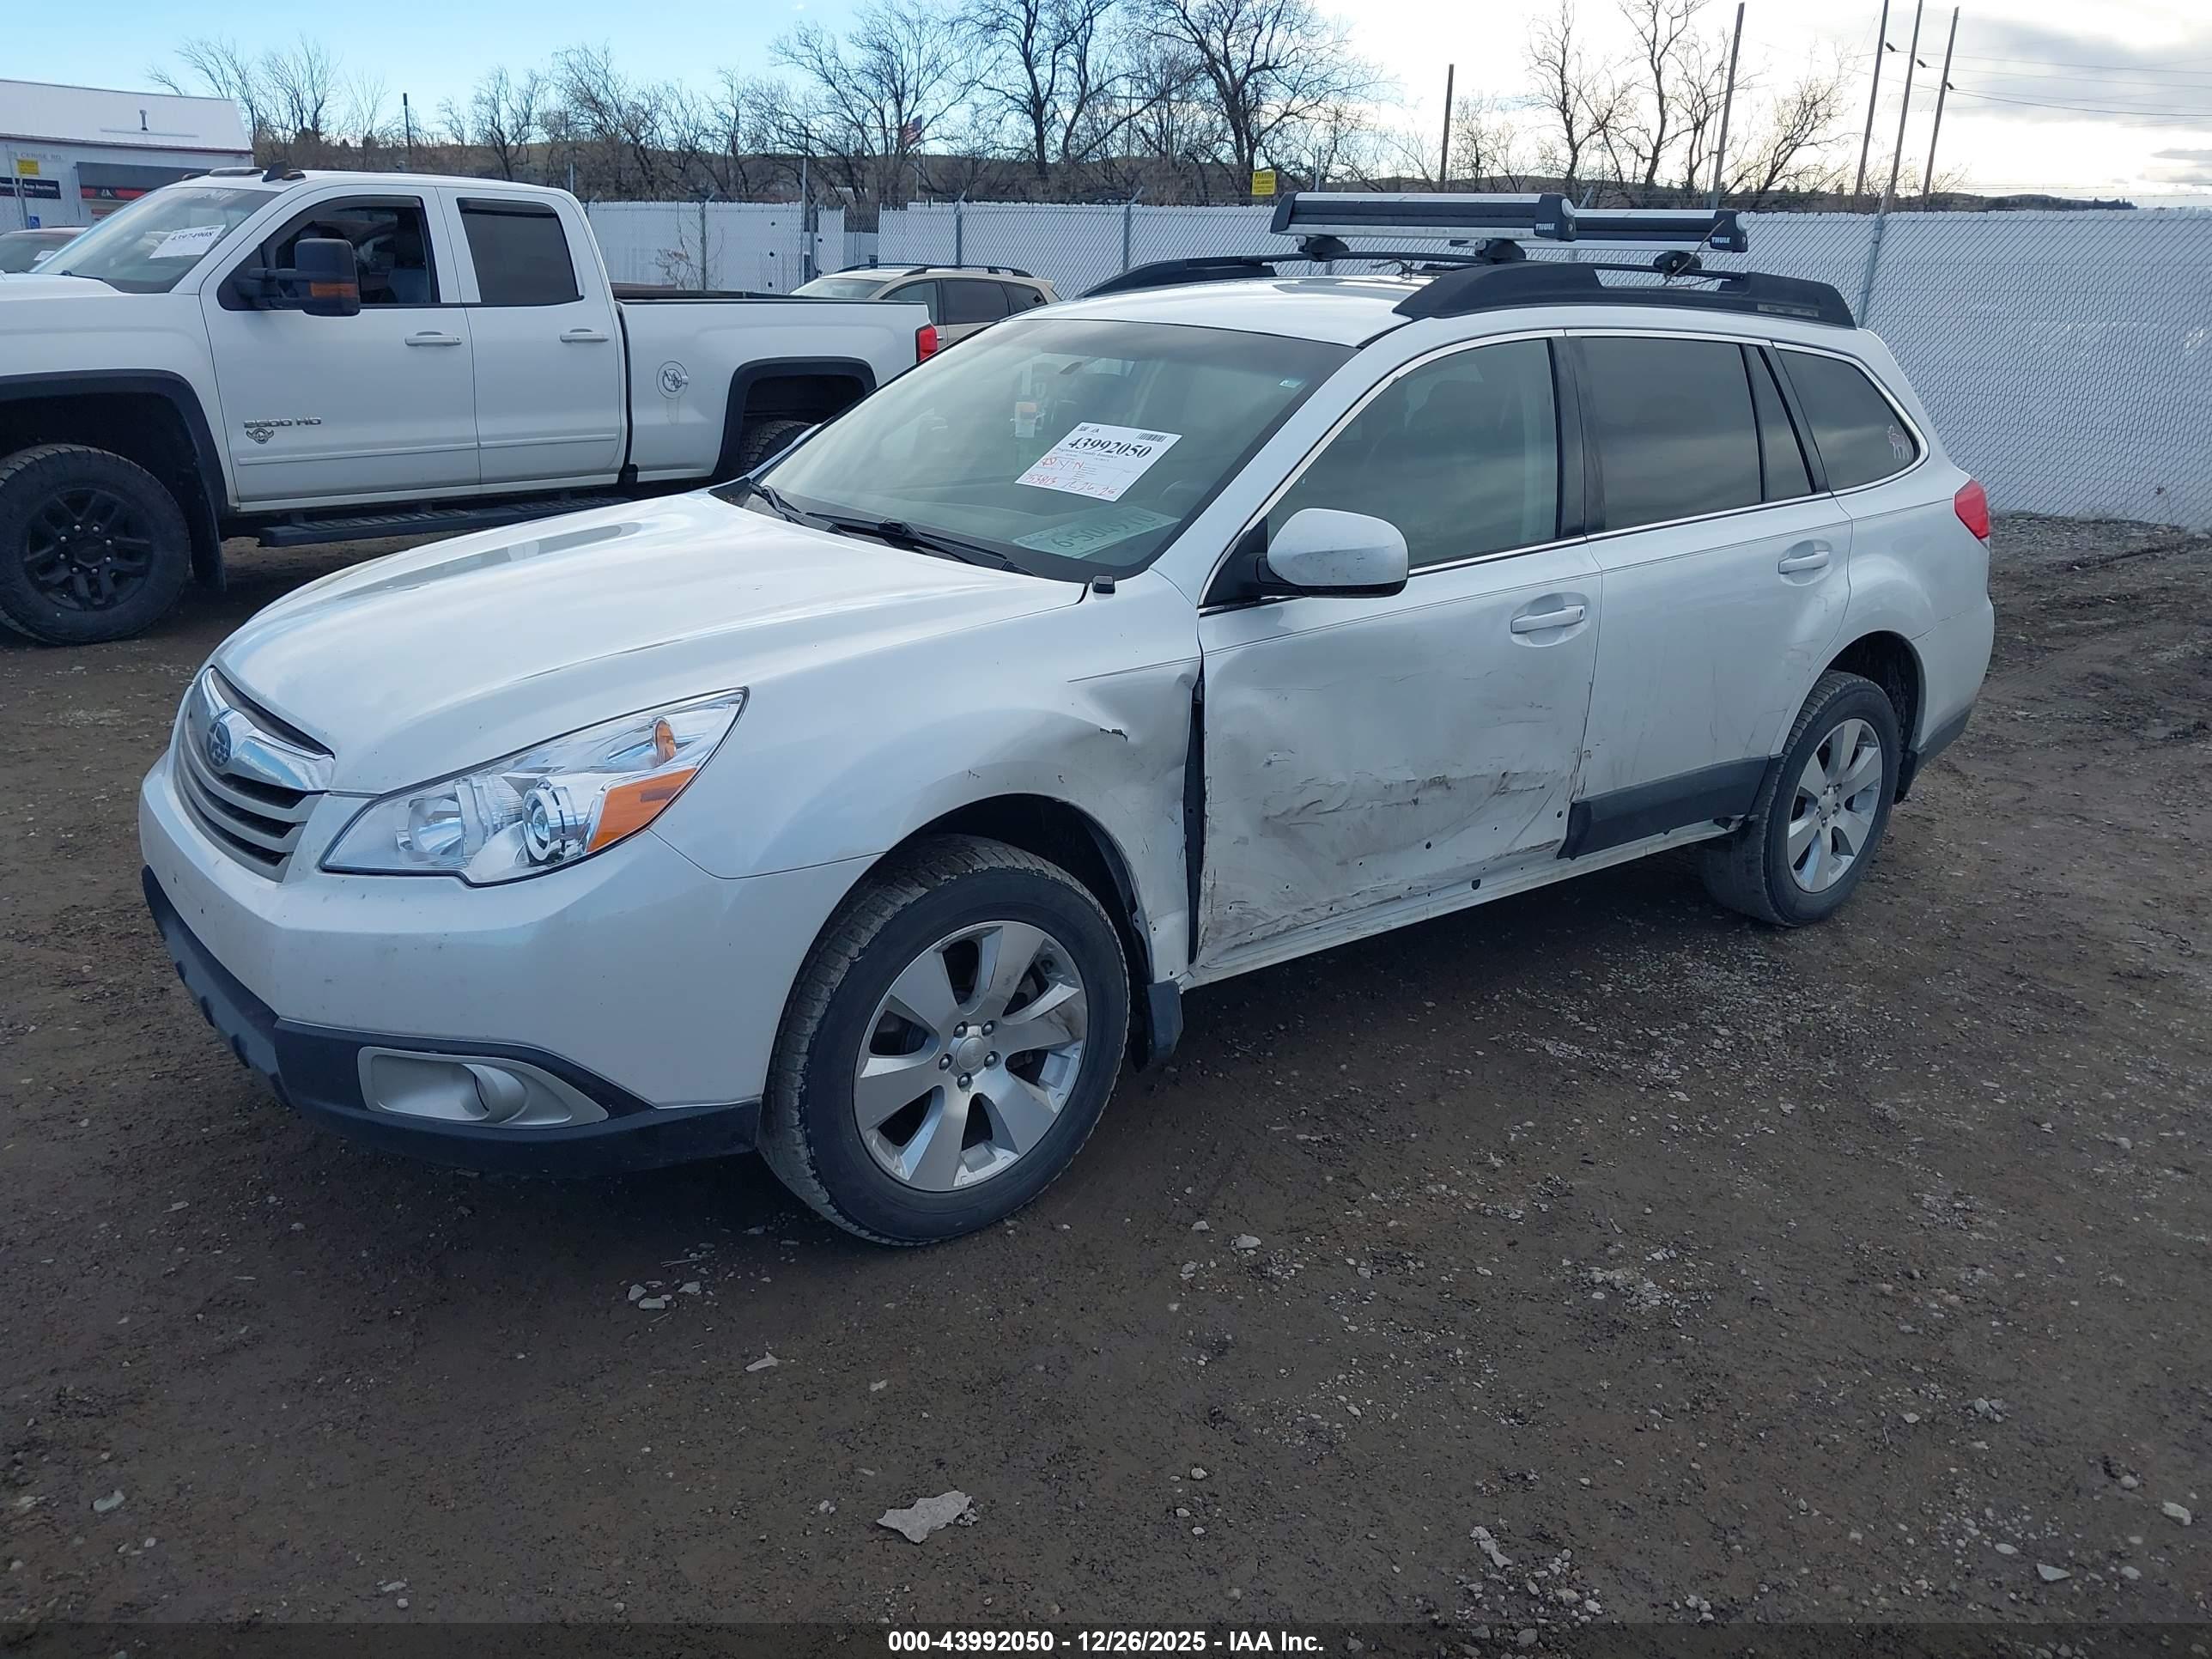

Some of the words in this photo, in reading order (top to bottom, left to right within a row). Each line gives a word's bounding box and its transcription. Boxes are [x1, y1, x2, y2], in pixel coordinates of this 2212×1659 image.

[1535, 222, 1555, 231] THULE
[243, 418, 293, 428] 2500
[295, 416, 322, 426] HD
[1068, 437, 1152, 458] 43992050
